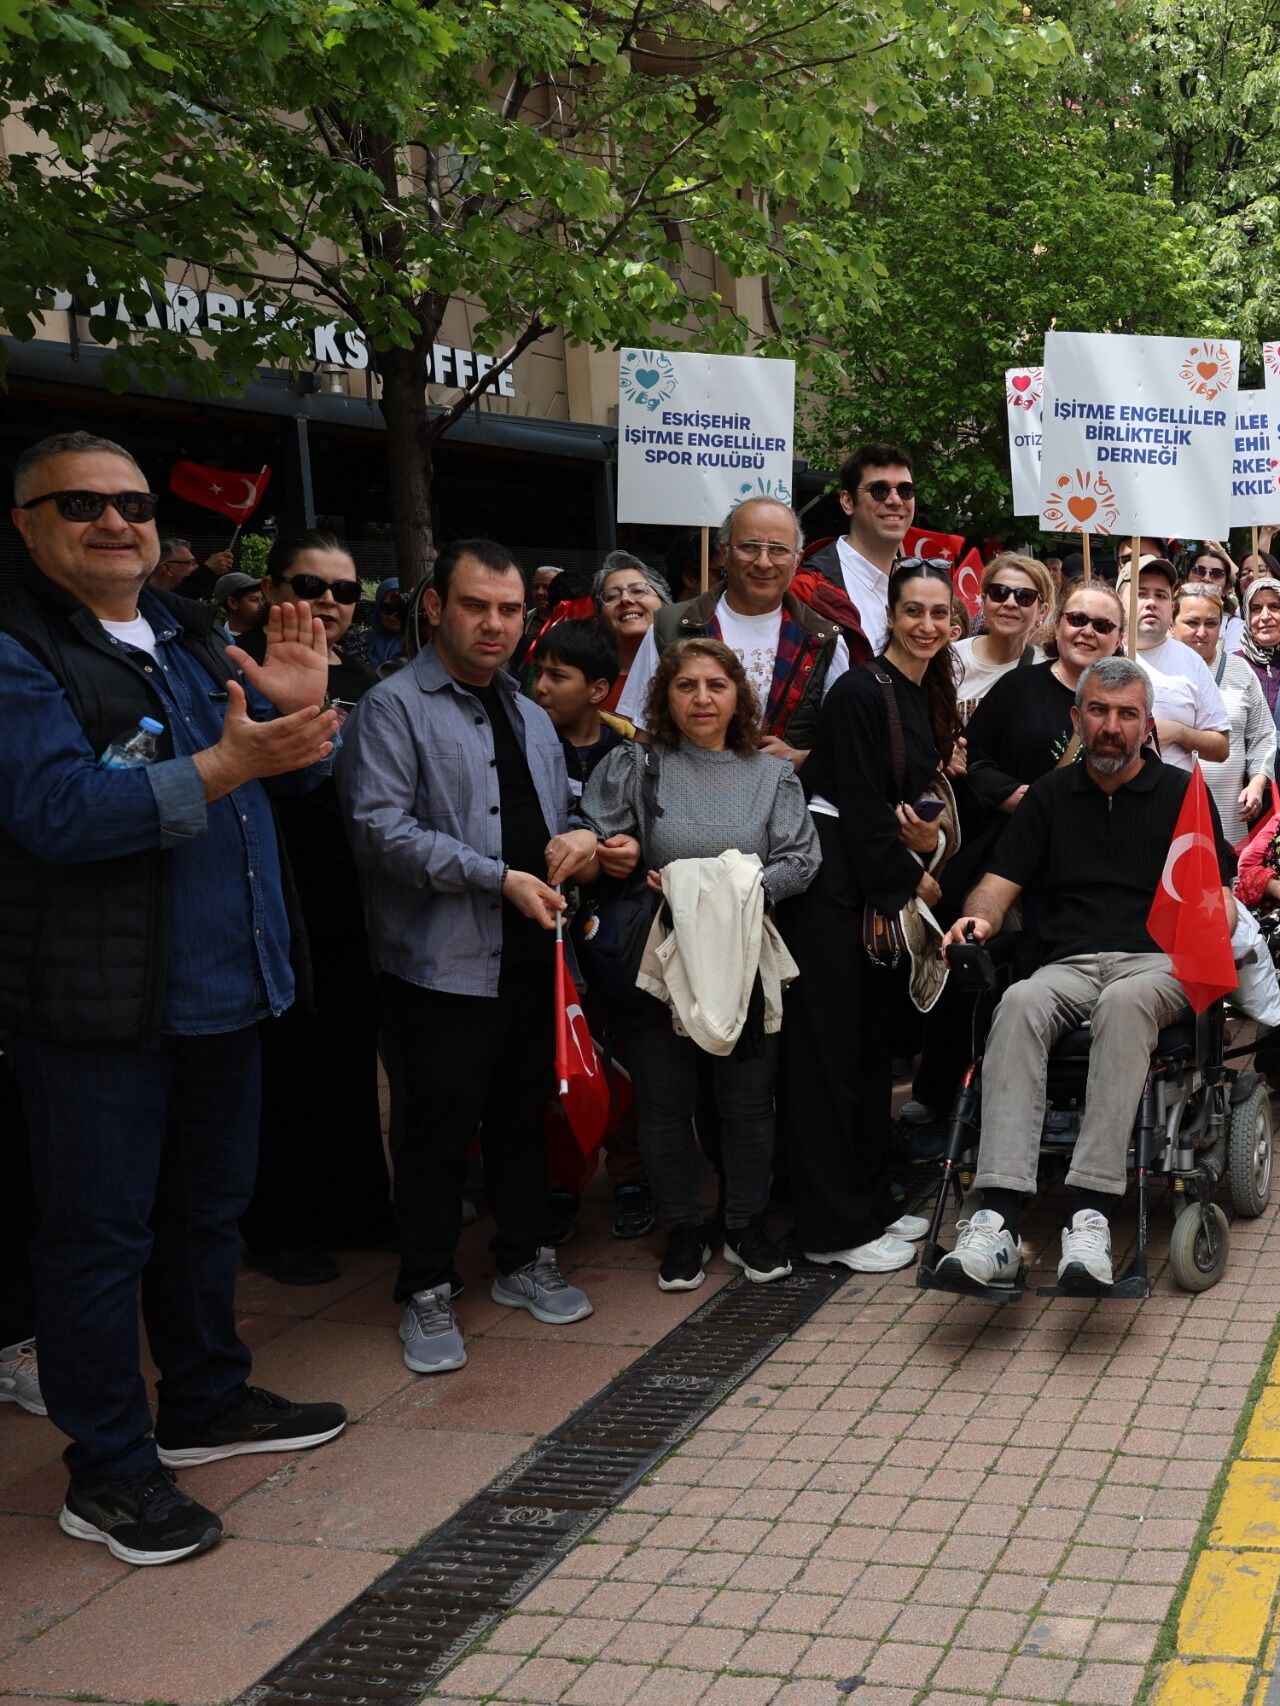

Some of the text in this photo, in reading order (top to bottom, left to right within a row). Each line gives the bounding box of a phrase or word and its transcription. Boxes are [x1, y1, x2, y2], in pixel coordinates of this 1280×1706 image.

[426, 344, 515, 397] FFEE
[662, 410, 750, 430] ESKİŞEHİR
[1054, 398, 1115, 421] İŞİTME
[1119, 405, 1227, 427] ENGELLİLER
[625, 425, 786, 451] İŞİTME ENGELLİLER
[1085, 422, 1192, 446] BİRLİKTELİK
[644, 449, 765, 469] SPOR KULÜBÜ
[1097, 445, 1178, 466] DERNEĞİ
